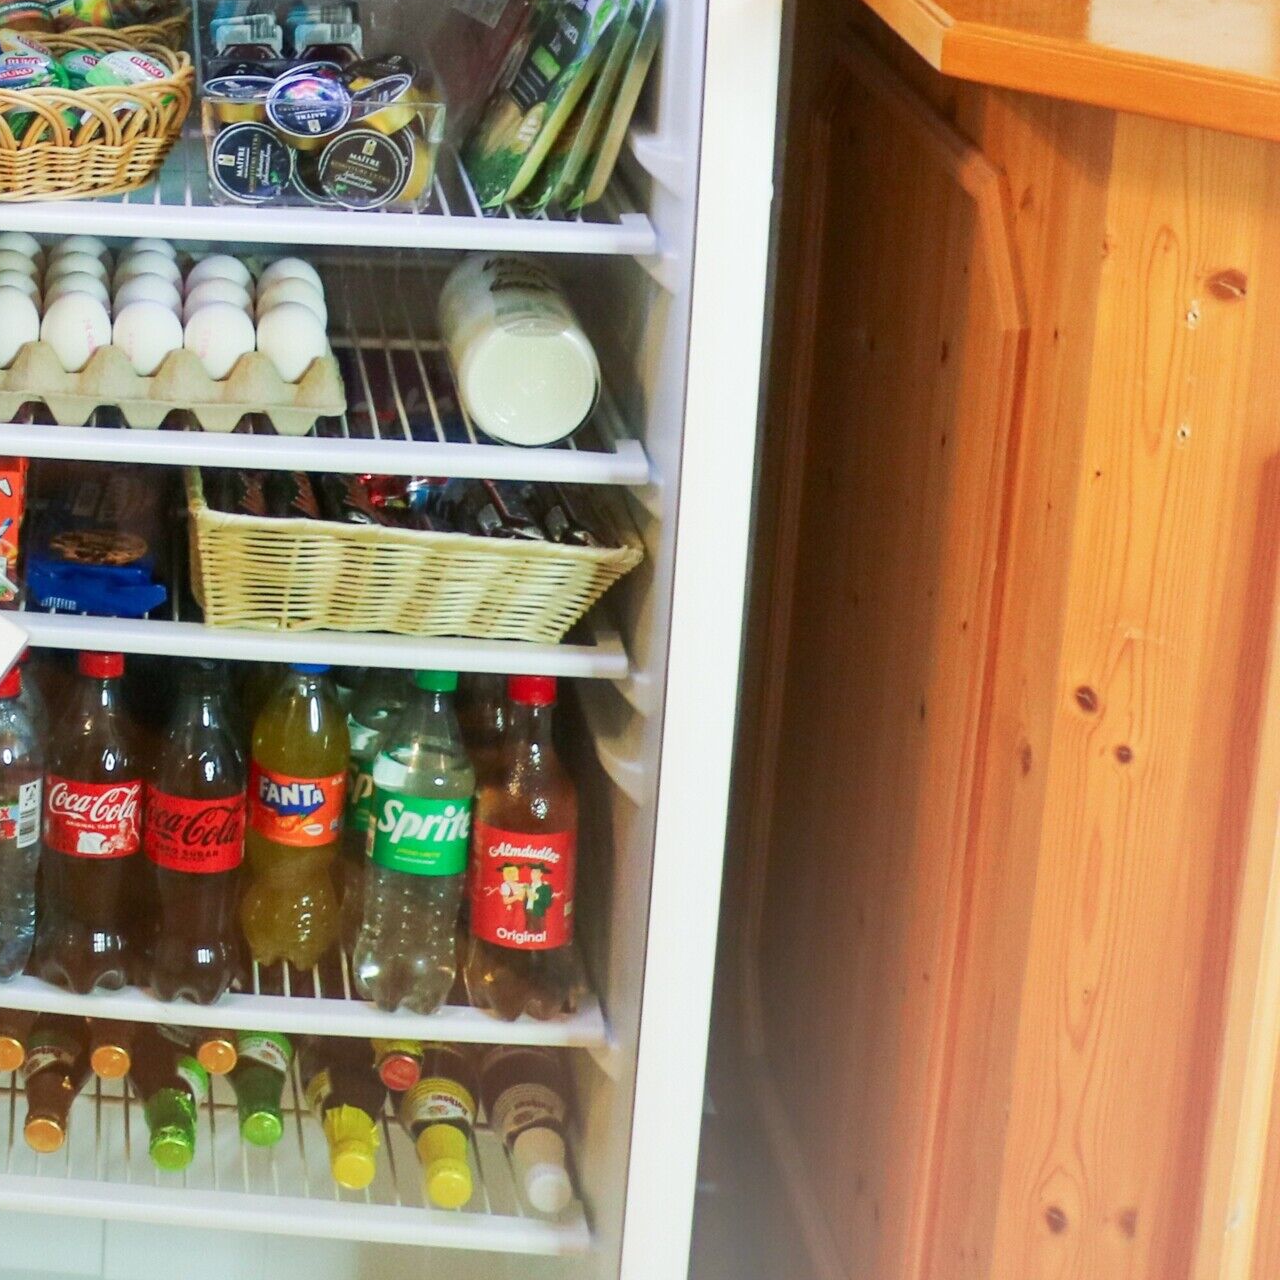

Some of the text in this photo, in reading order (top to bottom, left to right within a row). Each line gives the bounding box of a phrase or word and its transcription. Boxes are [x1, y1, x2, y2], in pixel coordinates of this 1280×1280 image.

[132, 57, 164, 78] BUKO
[48, 783, 140, 823] Coca-Cola
[260, 777, 325, 807] FANTA
[495, 926, 547, 945] Original
